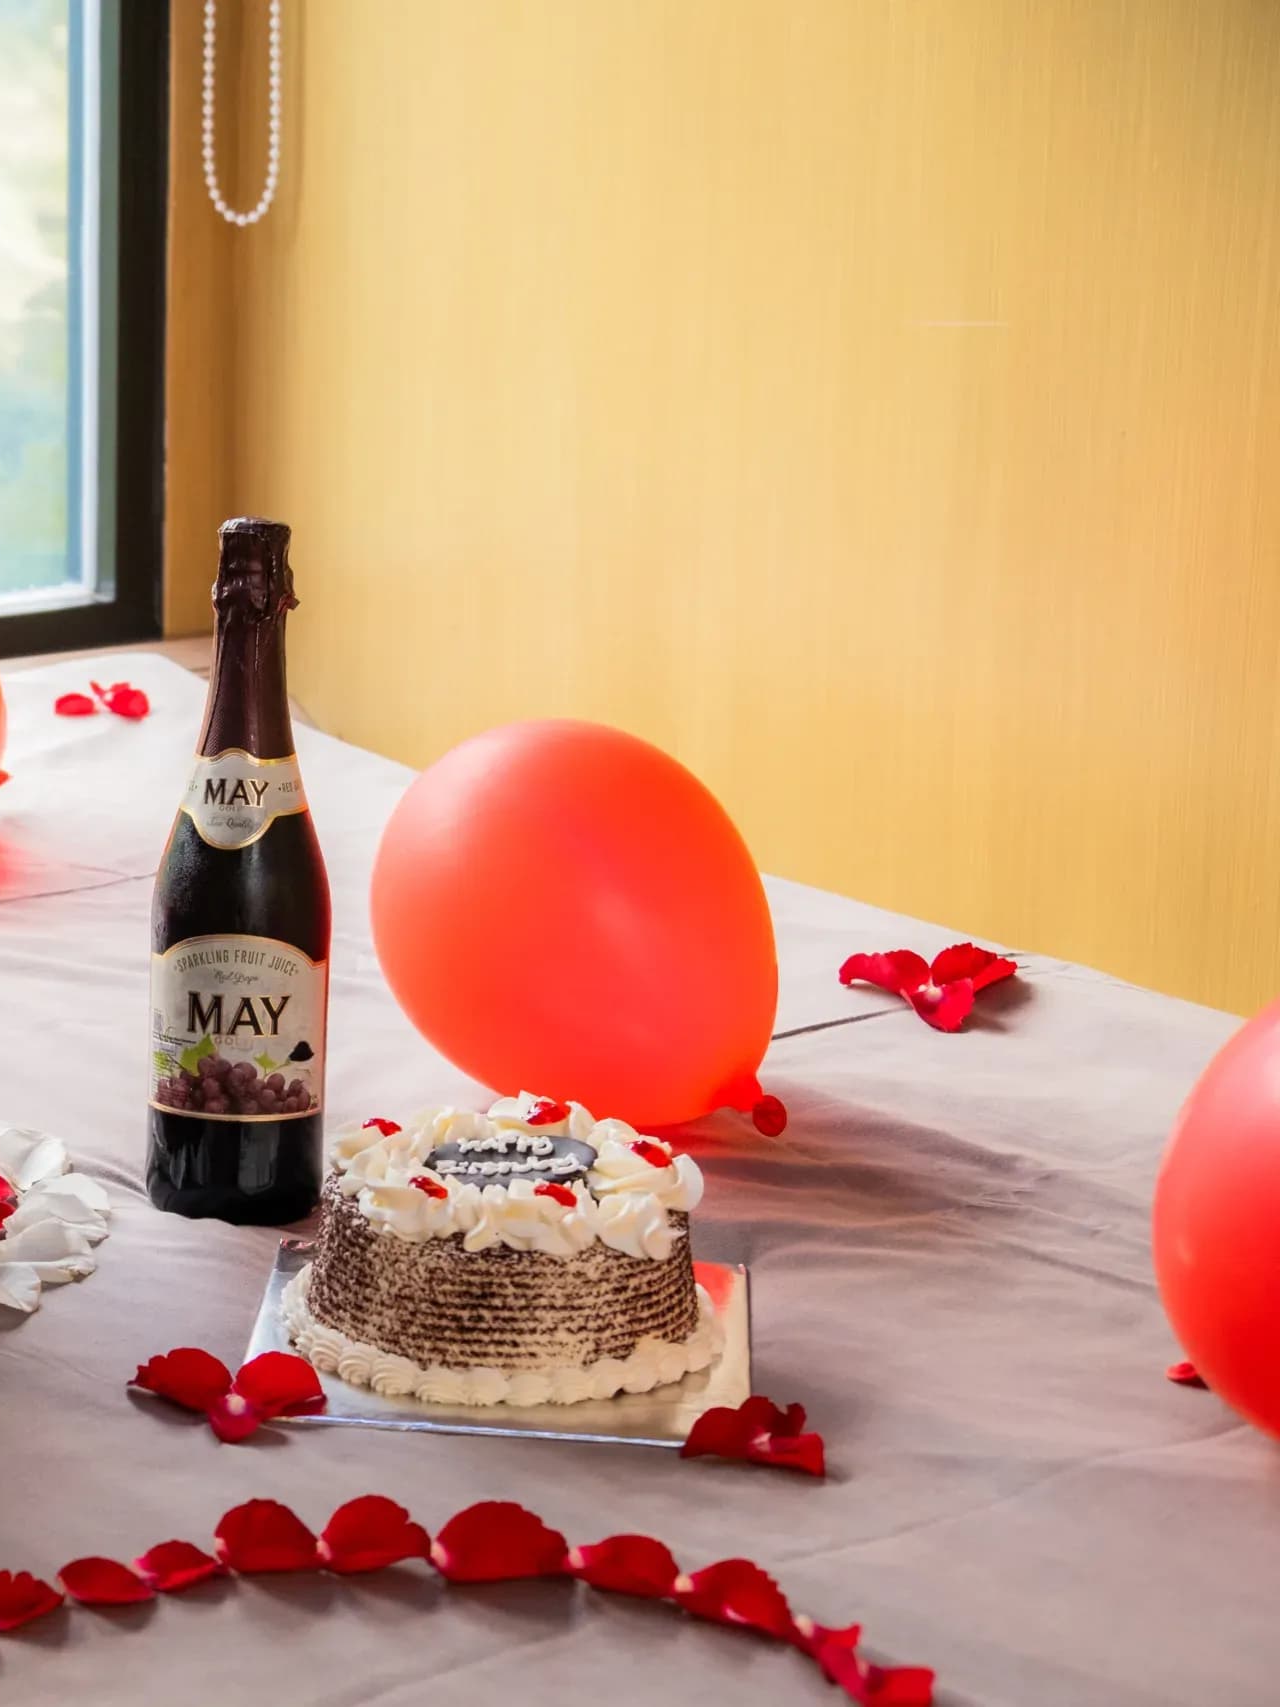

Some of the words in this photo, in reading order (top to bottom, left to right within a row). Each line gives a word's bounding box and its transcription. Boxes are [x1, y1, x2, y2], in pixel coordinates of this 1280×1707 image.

[204, 778, 270, 806] MAY
[176, 950, 230, 972] SPARKLING
[235, 950, 266, 964] FRUIT
[268, 955, 297, 976] JUICE
[187, 990, 291, 1036] MAY
[214, 1035, 253, 1047] GOL
